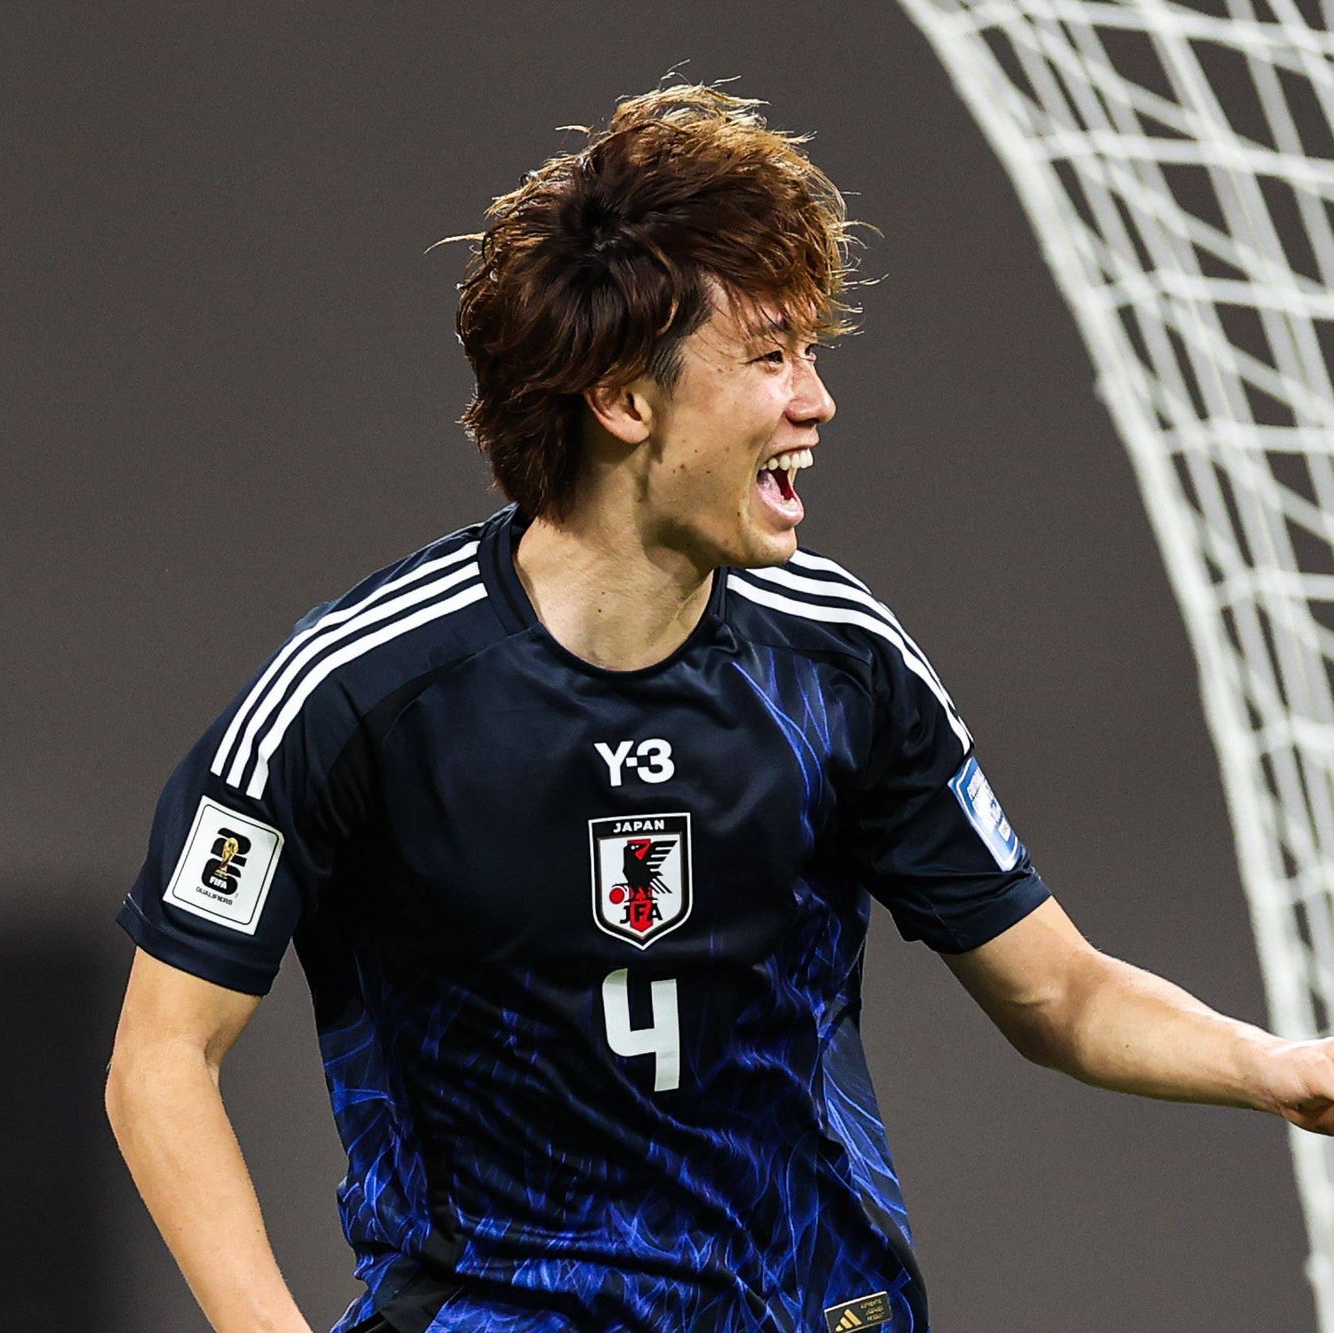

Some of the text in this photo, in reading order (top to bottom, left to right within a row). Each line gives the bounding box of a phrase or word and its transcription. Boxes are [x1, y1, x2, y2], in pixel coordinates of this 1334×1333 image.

[594, 738, 675, 787] Y-3
[613, 819, 665, 834] JAPAN
[209, 876, 228, 890] FIFA
[619, 902, 663, 924] JFA
[602, 968, 680, 1092] 4
